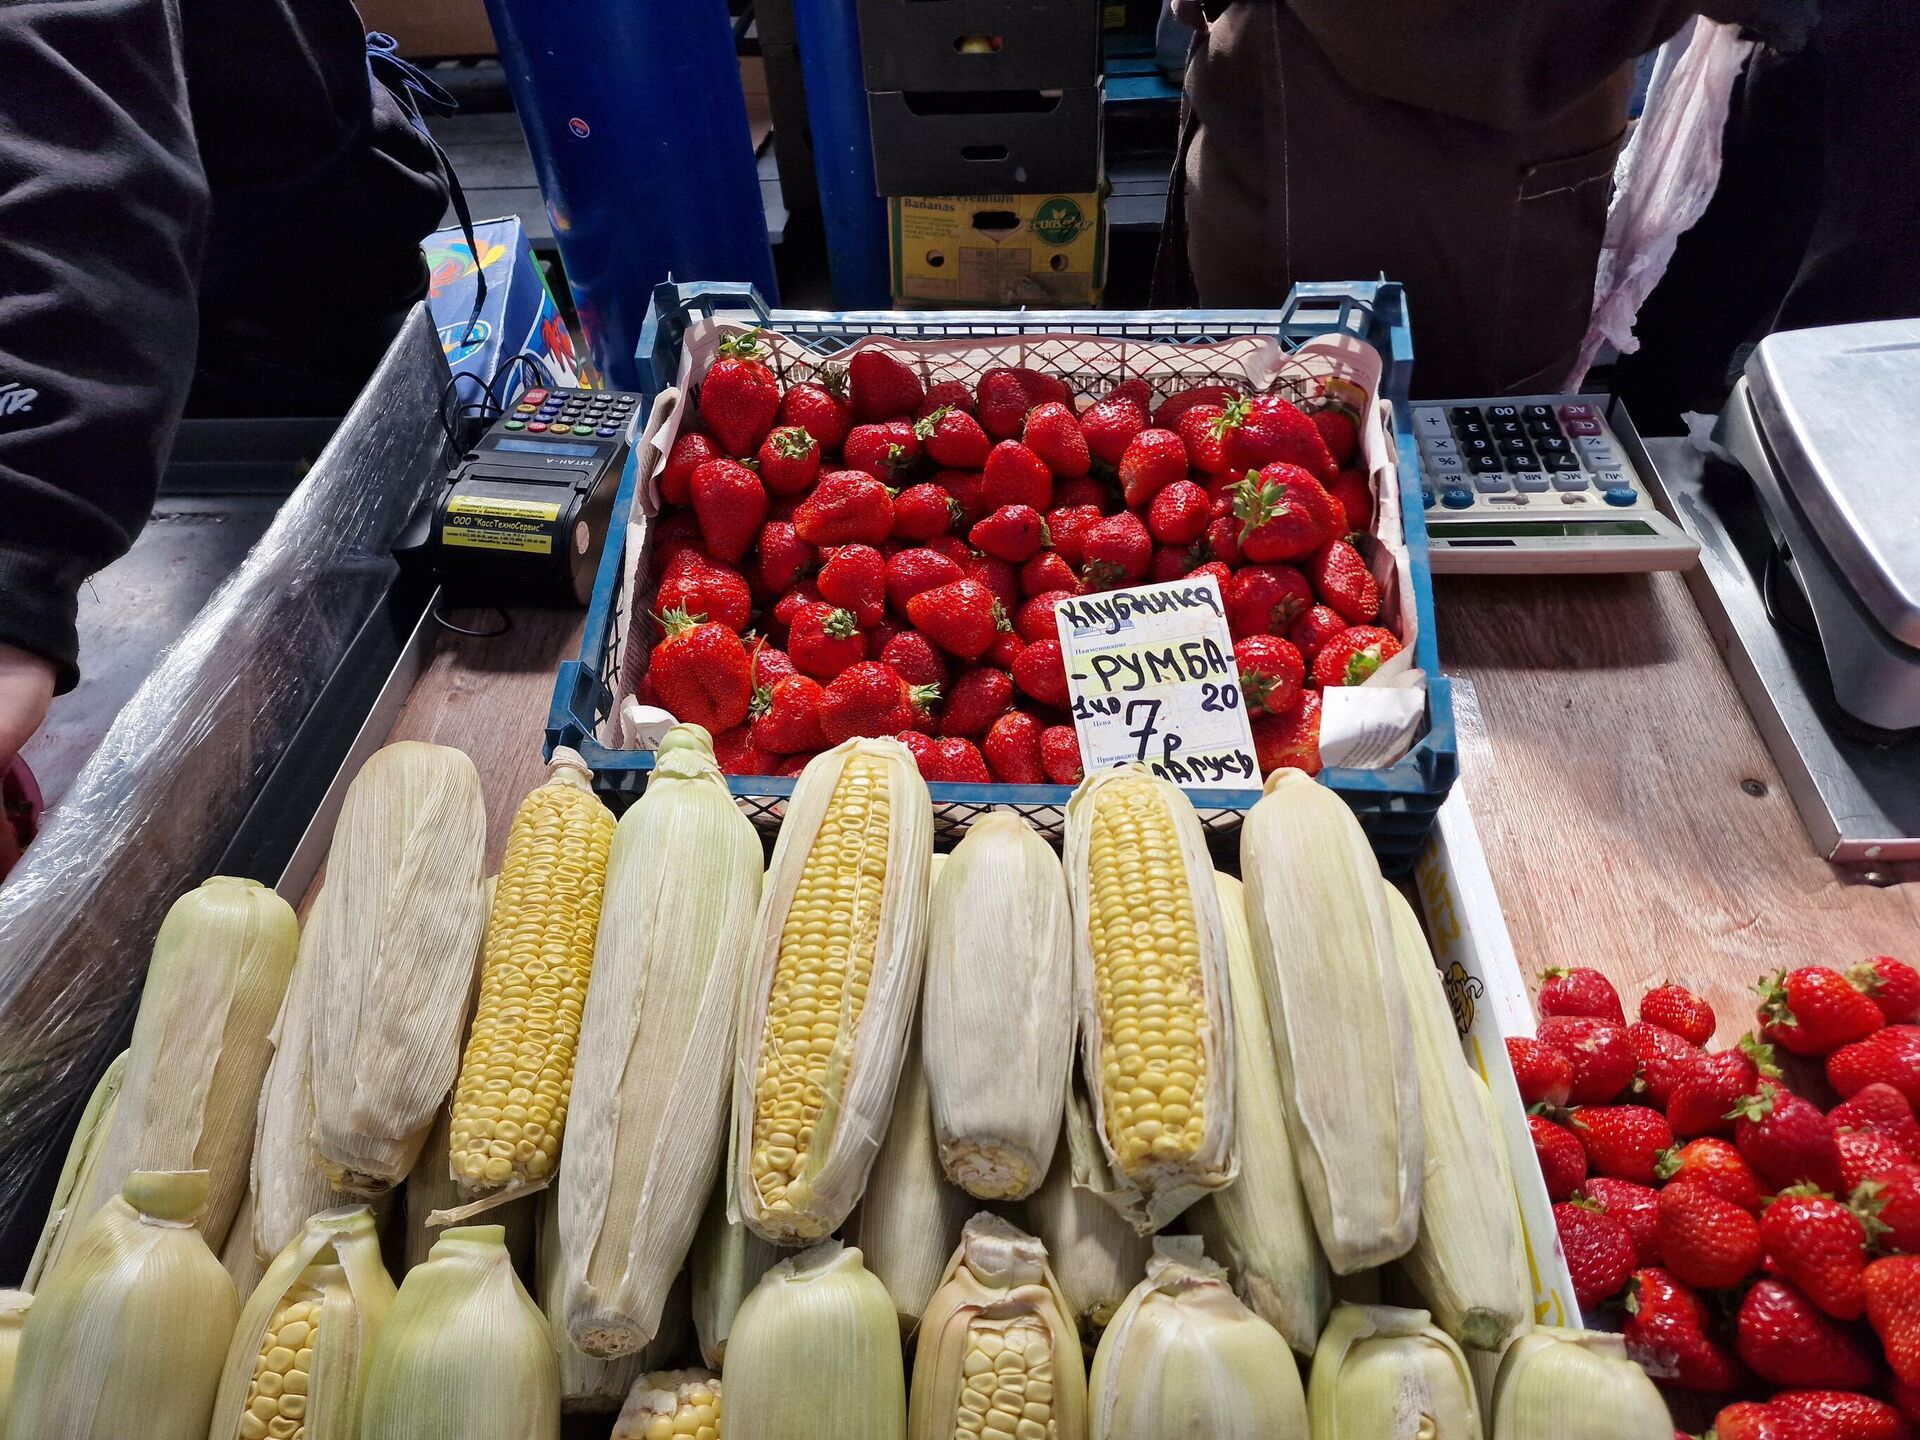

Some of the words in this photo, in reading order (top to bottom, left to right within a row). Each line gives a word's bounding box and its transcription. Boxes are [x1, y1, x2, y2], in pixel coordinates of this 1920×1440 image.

[904, 198, 955, 212] Bananas
[1494, 407, 1515, 416] 00
[1568, 405, 1586, 414] AC
[1468, 423, 1480, 432] 3
[1503, 422, 1518, 431] 2
[1576, 421, 1595, 430] CE
[1473, 440, 1486, 449] 6
[1511, 439, 1525, 448] 5
[1548, 438, 1562, 447] 4
[546, 458, 594, 466] ТИТАН-А
[1481, 456, 1494, 465] 9
[1516, 456, 1530, 465] 8
[1559, 455, 1571, 465] 7
[453, 515, 472, 526] ООО
[1075, 642, 1128, 655] Наименование
[1201, 683, 1239, 712] 20
[1092, 719, 1112, 728] Цена
[1125, 699, 1163, 760] 7
